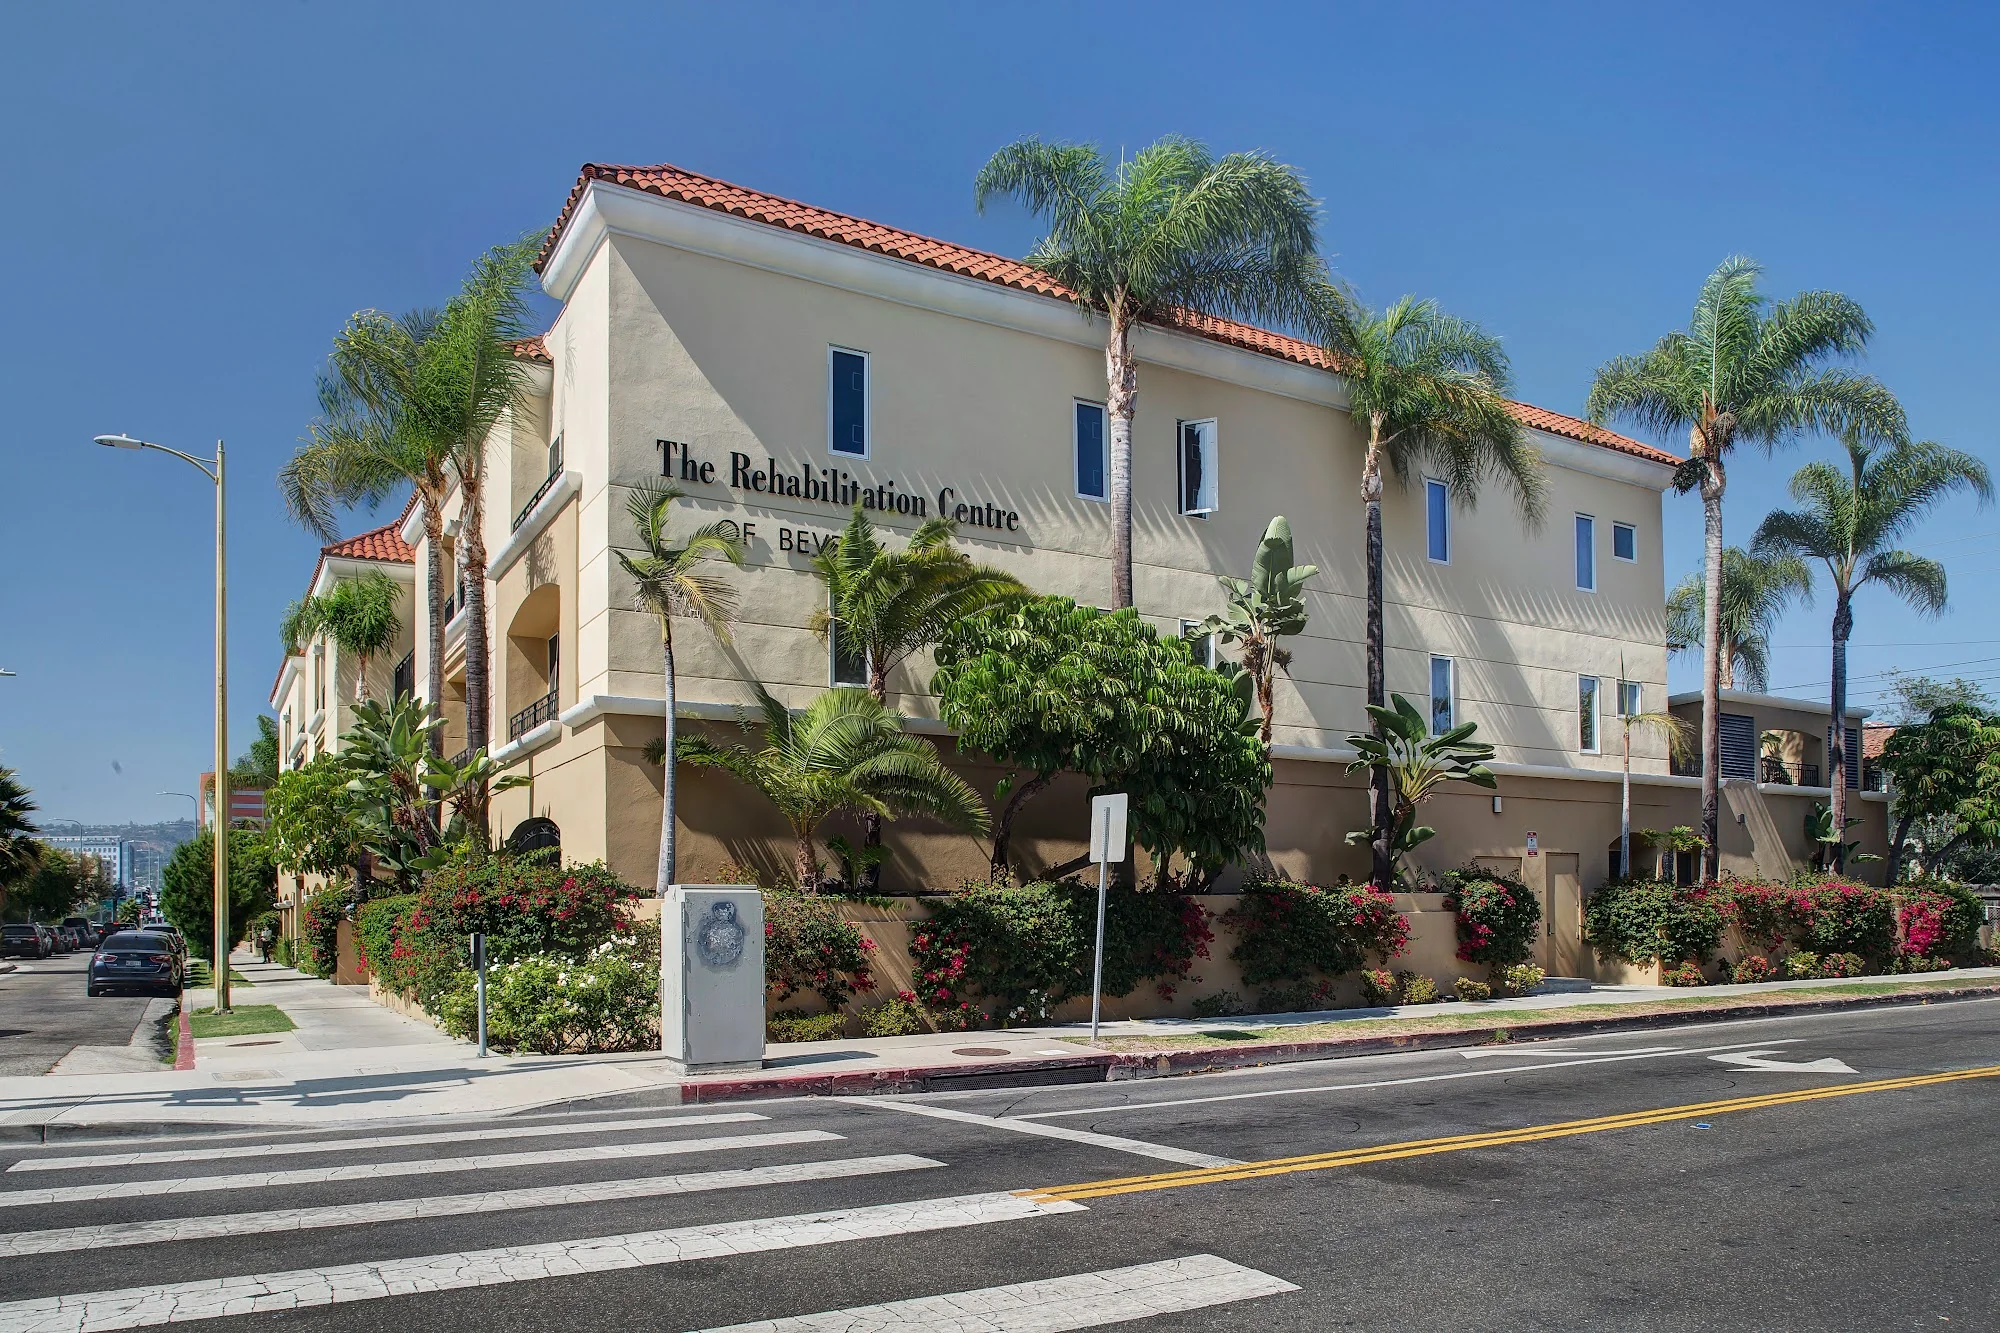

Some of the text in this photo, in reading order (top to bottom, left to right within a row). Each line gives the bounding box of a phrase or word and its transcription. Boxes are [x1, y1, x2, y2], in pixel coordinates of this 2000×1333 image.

[657, 439, 1019, 531] The Rehabilitation Centre
